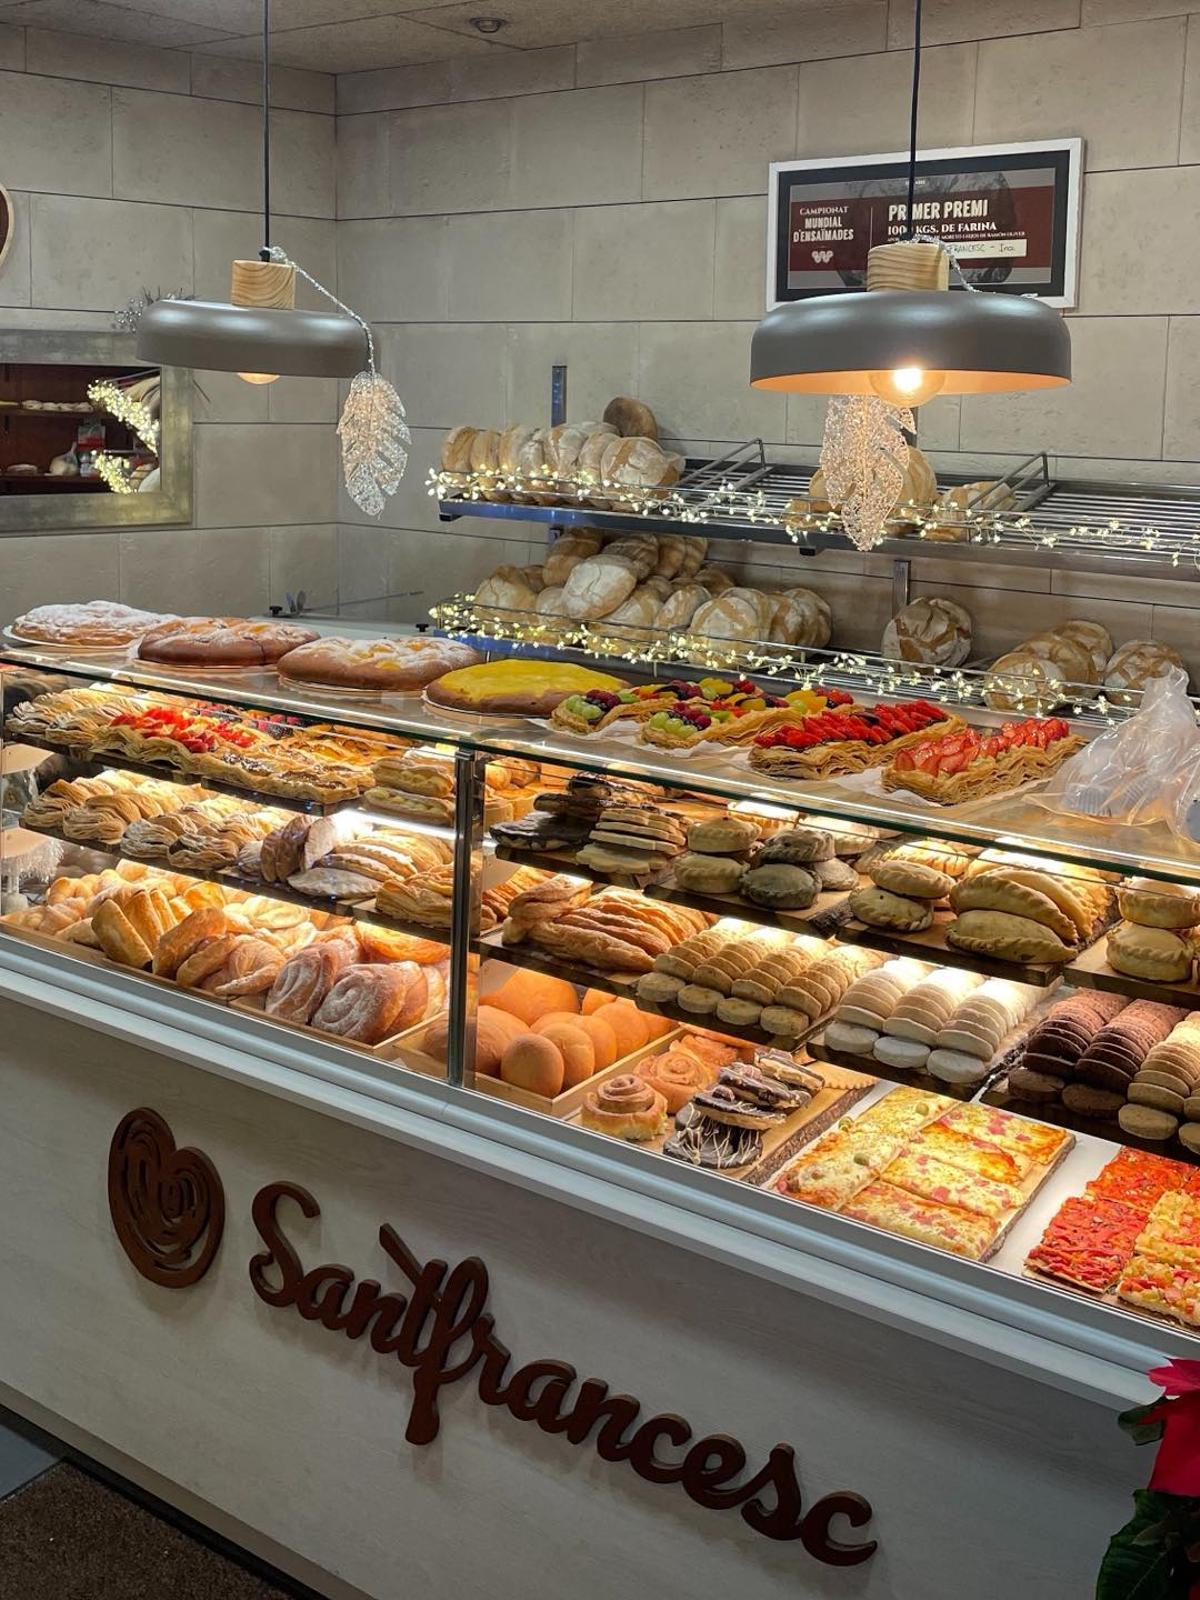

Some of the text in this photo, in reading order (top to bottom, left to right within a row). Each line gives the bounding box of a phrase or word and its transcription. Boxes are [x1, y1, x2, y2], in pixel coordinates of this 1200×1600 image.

[800, 206, 849, 215] CAMPIONAT
[888, 199, 988, 221] PRMER PREMI
[805, 216, 843, 229] MUNDIAL
[916, 224, 939, 234] KGS.
[941, 222, 956, 233] DE
[958, 220, 997, 232] FARINA
